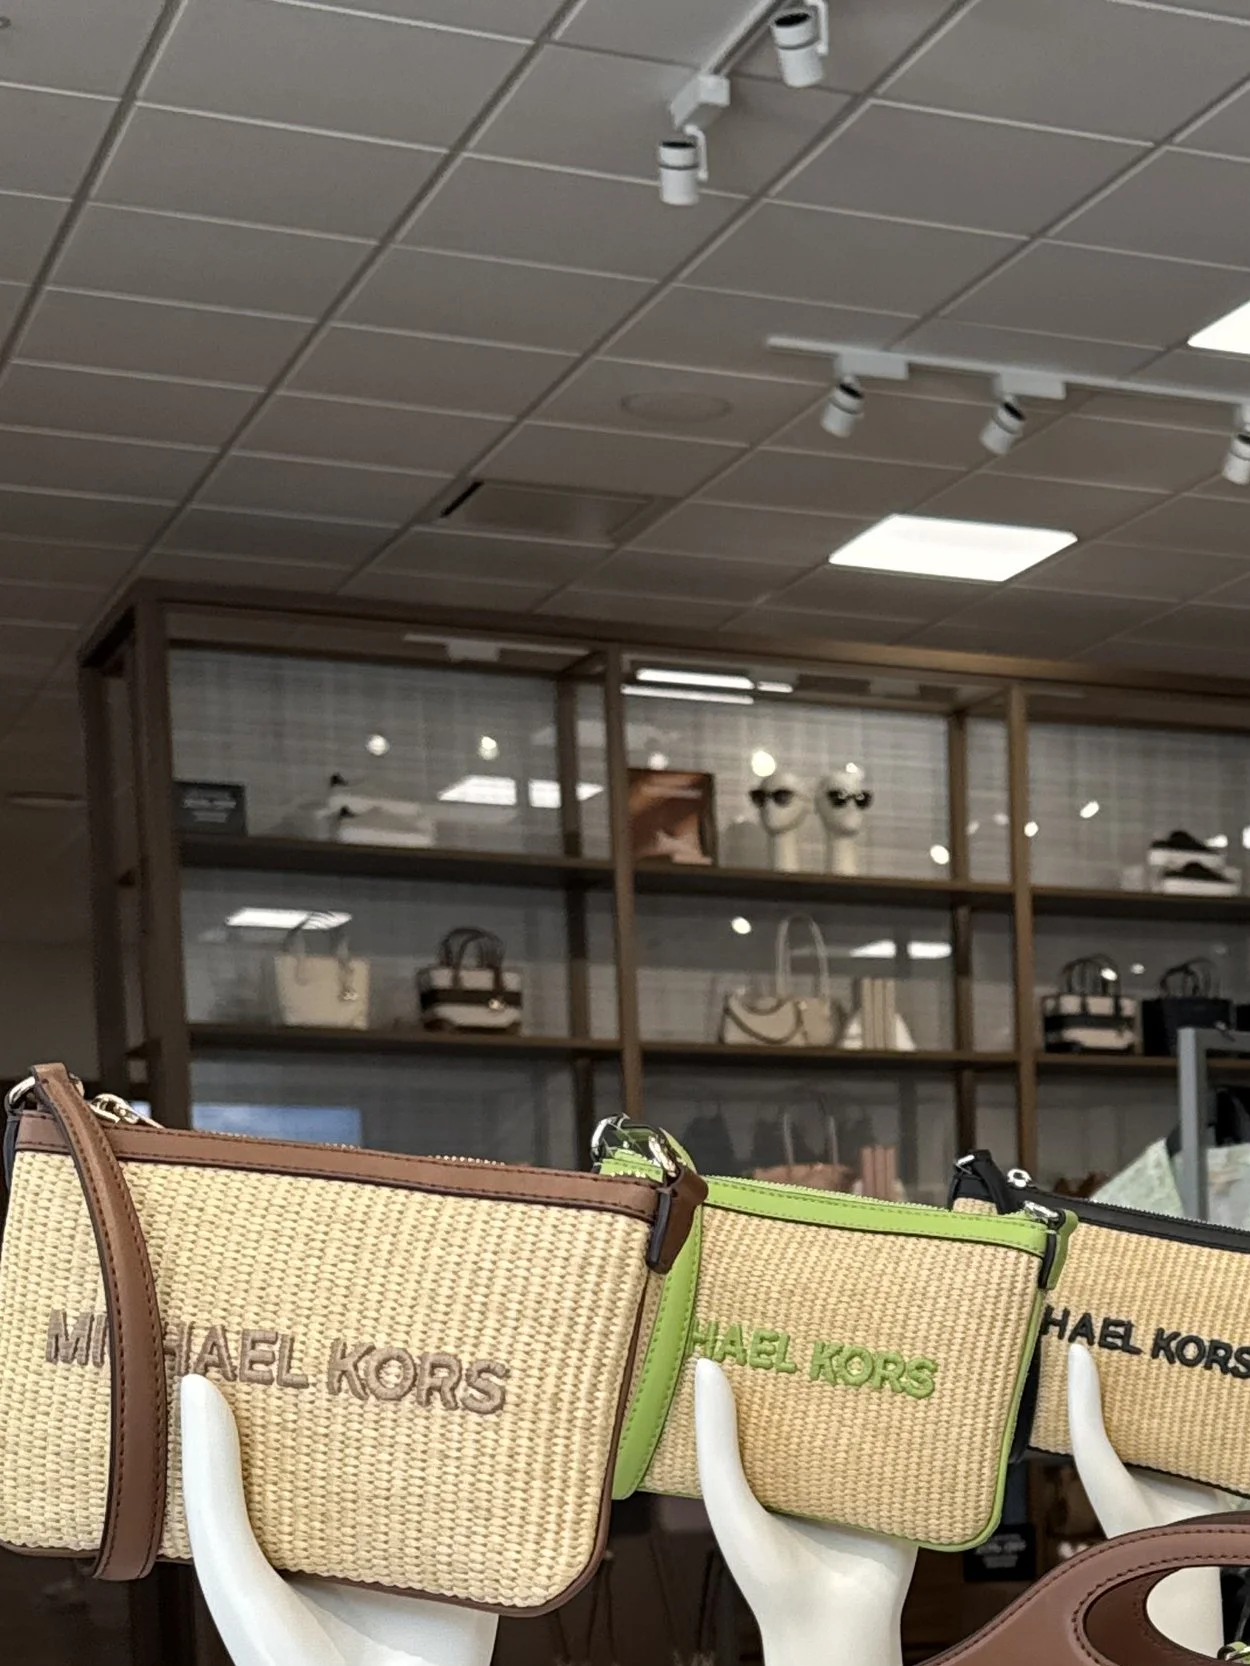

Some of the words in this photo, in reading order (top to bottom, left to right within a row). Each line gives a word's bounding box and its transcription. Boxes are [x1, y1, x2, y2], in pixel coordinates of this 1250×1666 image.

[46, 1308, 309, 1388] MIHAEL
[328, 1338, 509, 1415] KORS
[809, 1341, 939, 1399] KORS
